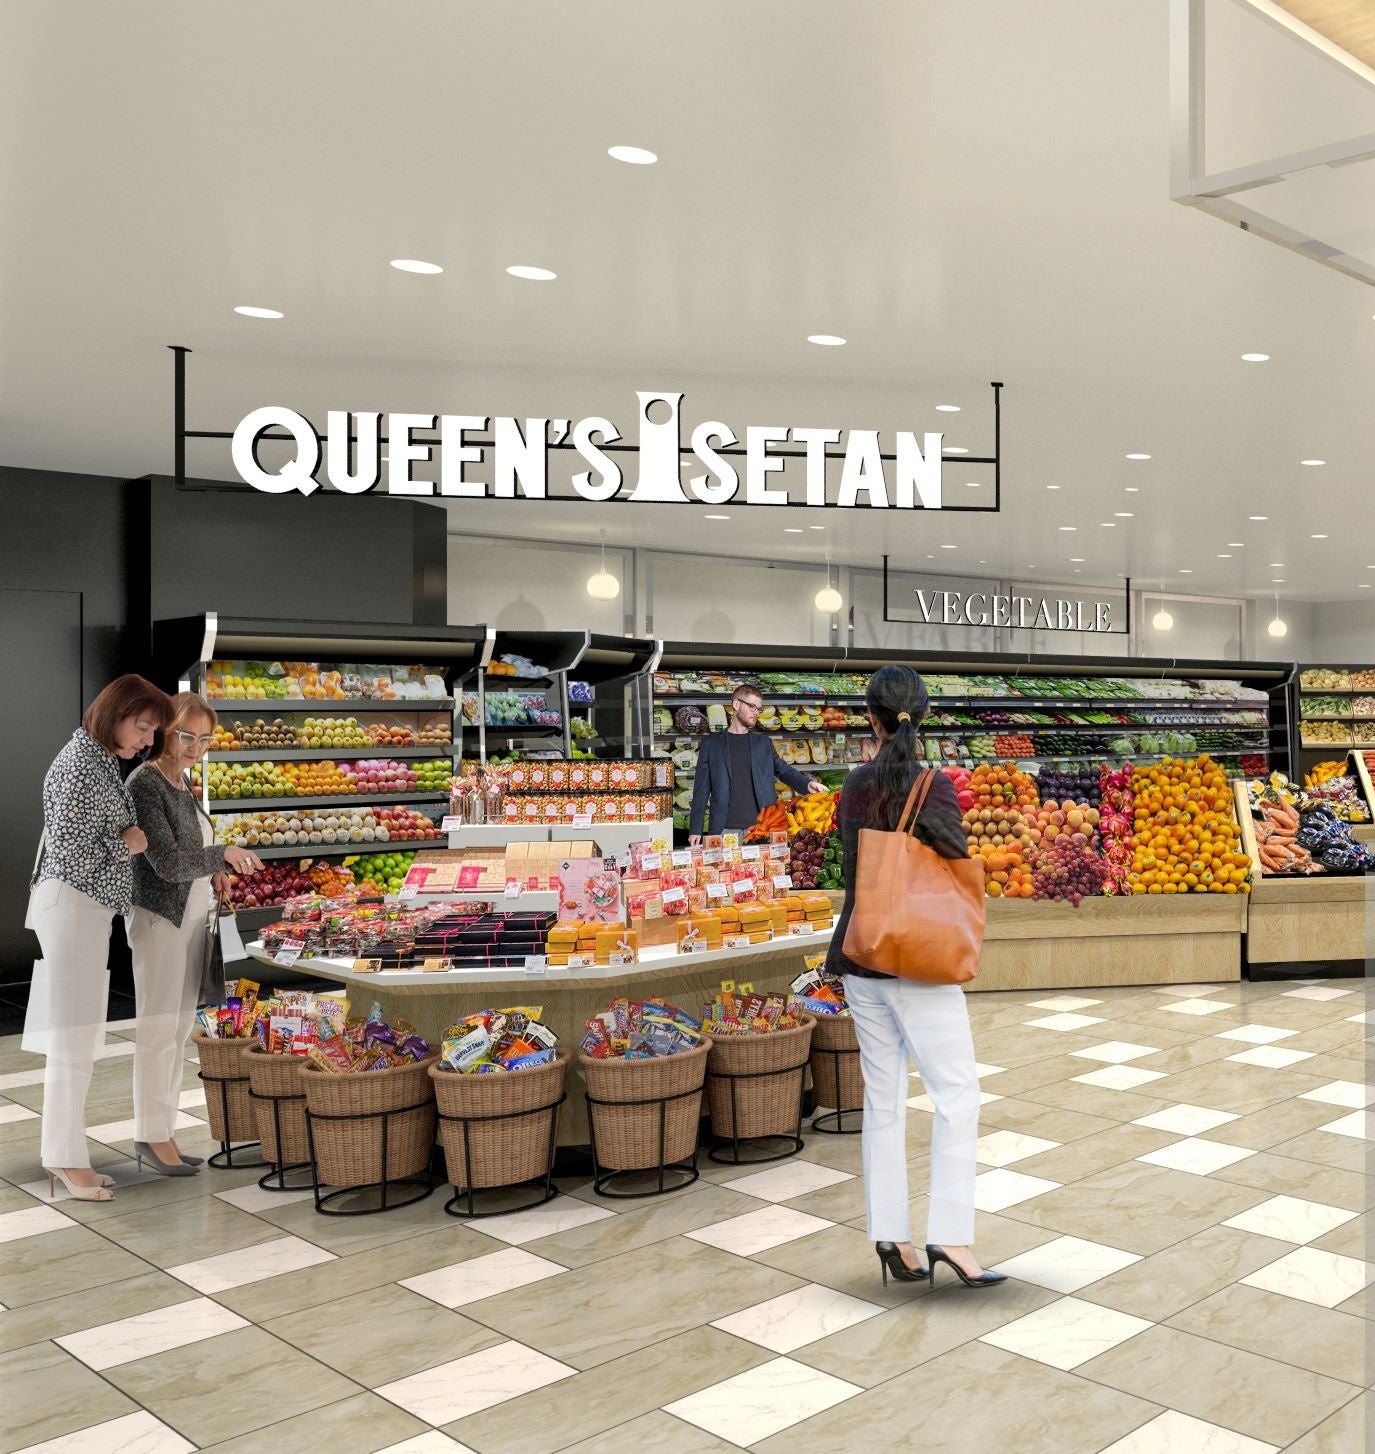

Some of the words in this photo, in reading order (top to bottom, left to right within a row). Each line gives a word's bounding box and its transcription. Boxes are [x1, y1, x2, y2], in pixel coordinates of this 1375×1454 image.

[231, 405, 623, 498] QUEEN'S
[627, 391, 945, 509] ISETAN
[913, 589, 1112, 632] VEGETABLE
